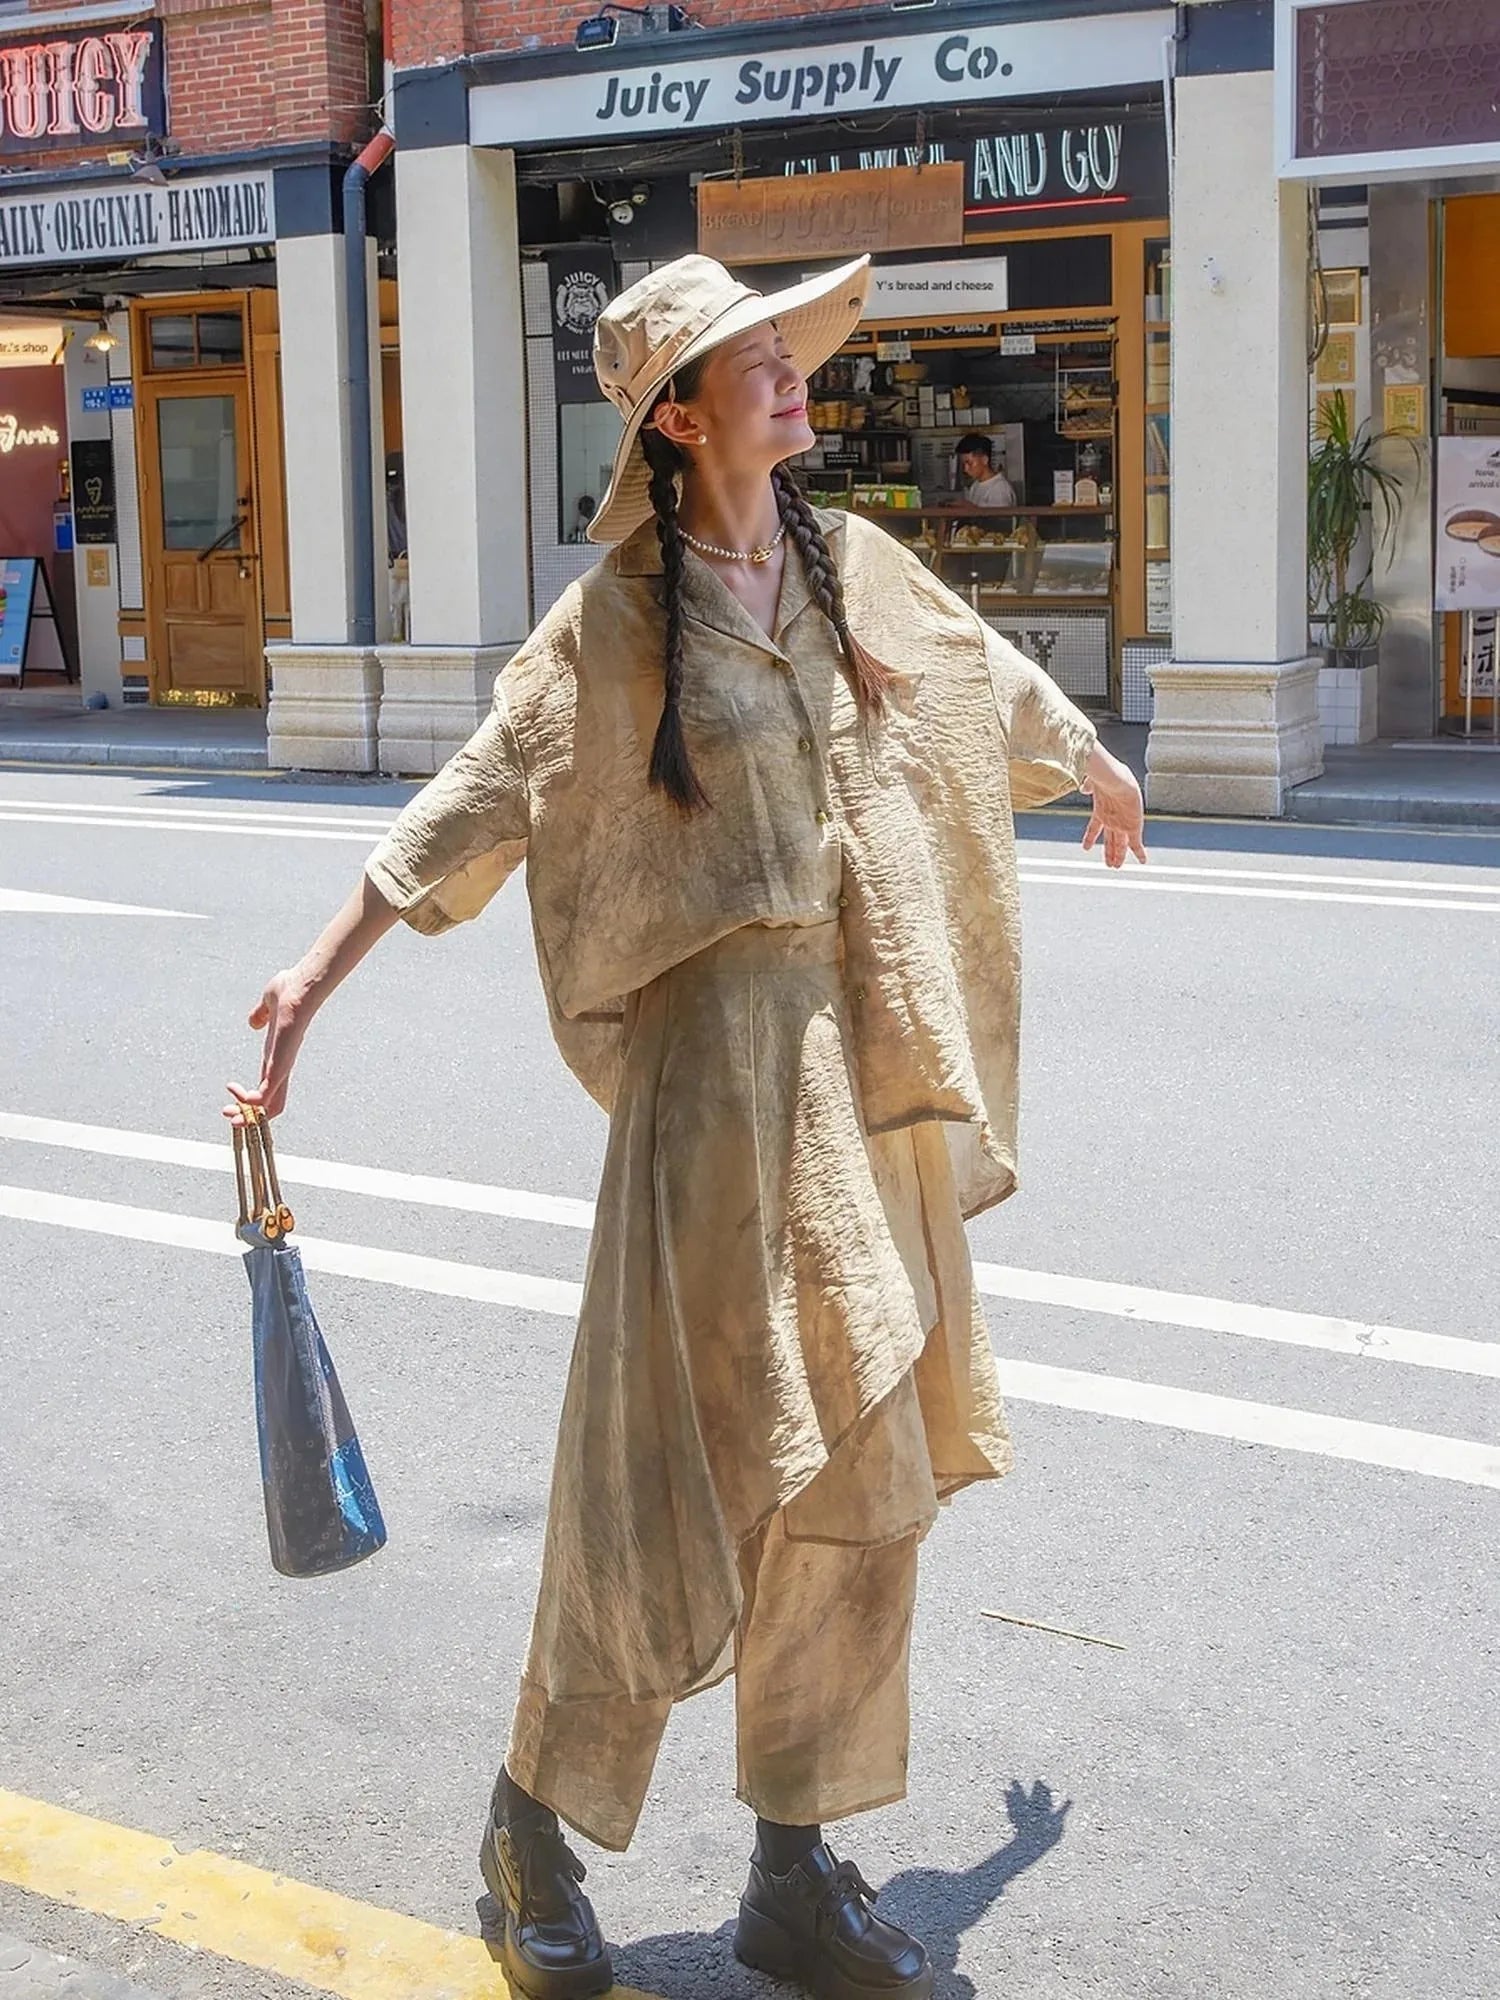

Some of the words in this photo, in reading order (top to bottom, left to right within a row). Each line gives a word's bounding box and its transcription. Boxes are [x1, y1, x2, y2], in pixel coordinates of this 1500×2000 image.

[0, 32, 153, 138] UICY
[596, 72, 710, 121] Juicy
[735, 45, 902, 110] Supply
[934, 35, 1013, 82] Co.
[974, 132, 1048, 200] AND
[1062, 125, 1123, 194] GO
[767, 187, 886, 241] JUICY
[564, 270, 601, 288] JUICY
[876, 281, 894, 291] Y's
[896, 280, 929, 291] bread
[931, 280, 952, 291] and
[954, 280, 994, 291] cheese
[23, 341, 49, 355] shop
